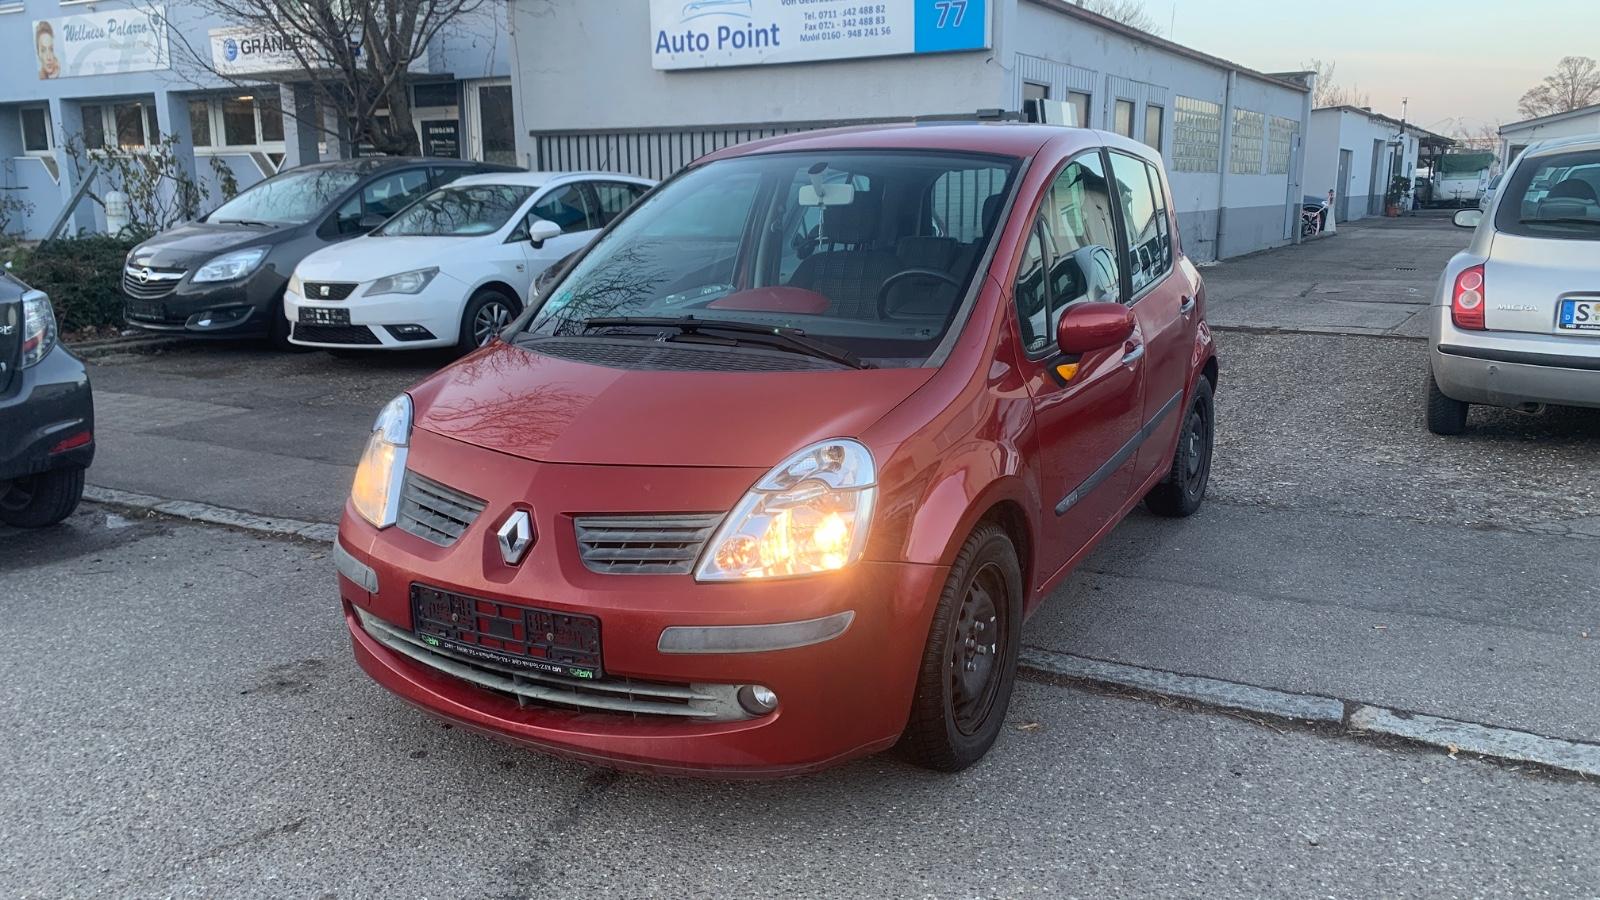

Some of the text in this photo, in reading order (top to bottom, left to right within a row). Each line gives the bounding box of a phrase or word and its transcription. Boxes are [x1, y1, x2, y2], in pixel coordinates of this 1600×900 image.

[804, 12, 817, 21] Tel.
[818, 10, 837, 19] 0711
[859, 6, 874, 15] 488
[875, 5, 885, 14] 82
[934, 0, 968, 28] 77
[804, 23, 816, 31] Fax
[842, 19, 856, 28] 342
[859, 17, 874, 26] 488
[875, 16, 885, 25] 83
[63, 24, 104, 42] Wellness
[655, 22, 780, 54] Auto Point
[821, 30, 841, 40] 0160
[864, 27, 879, 37] 241
[880, 26, 891, 36] 56
[1575, 303, 1590, 322] S
